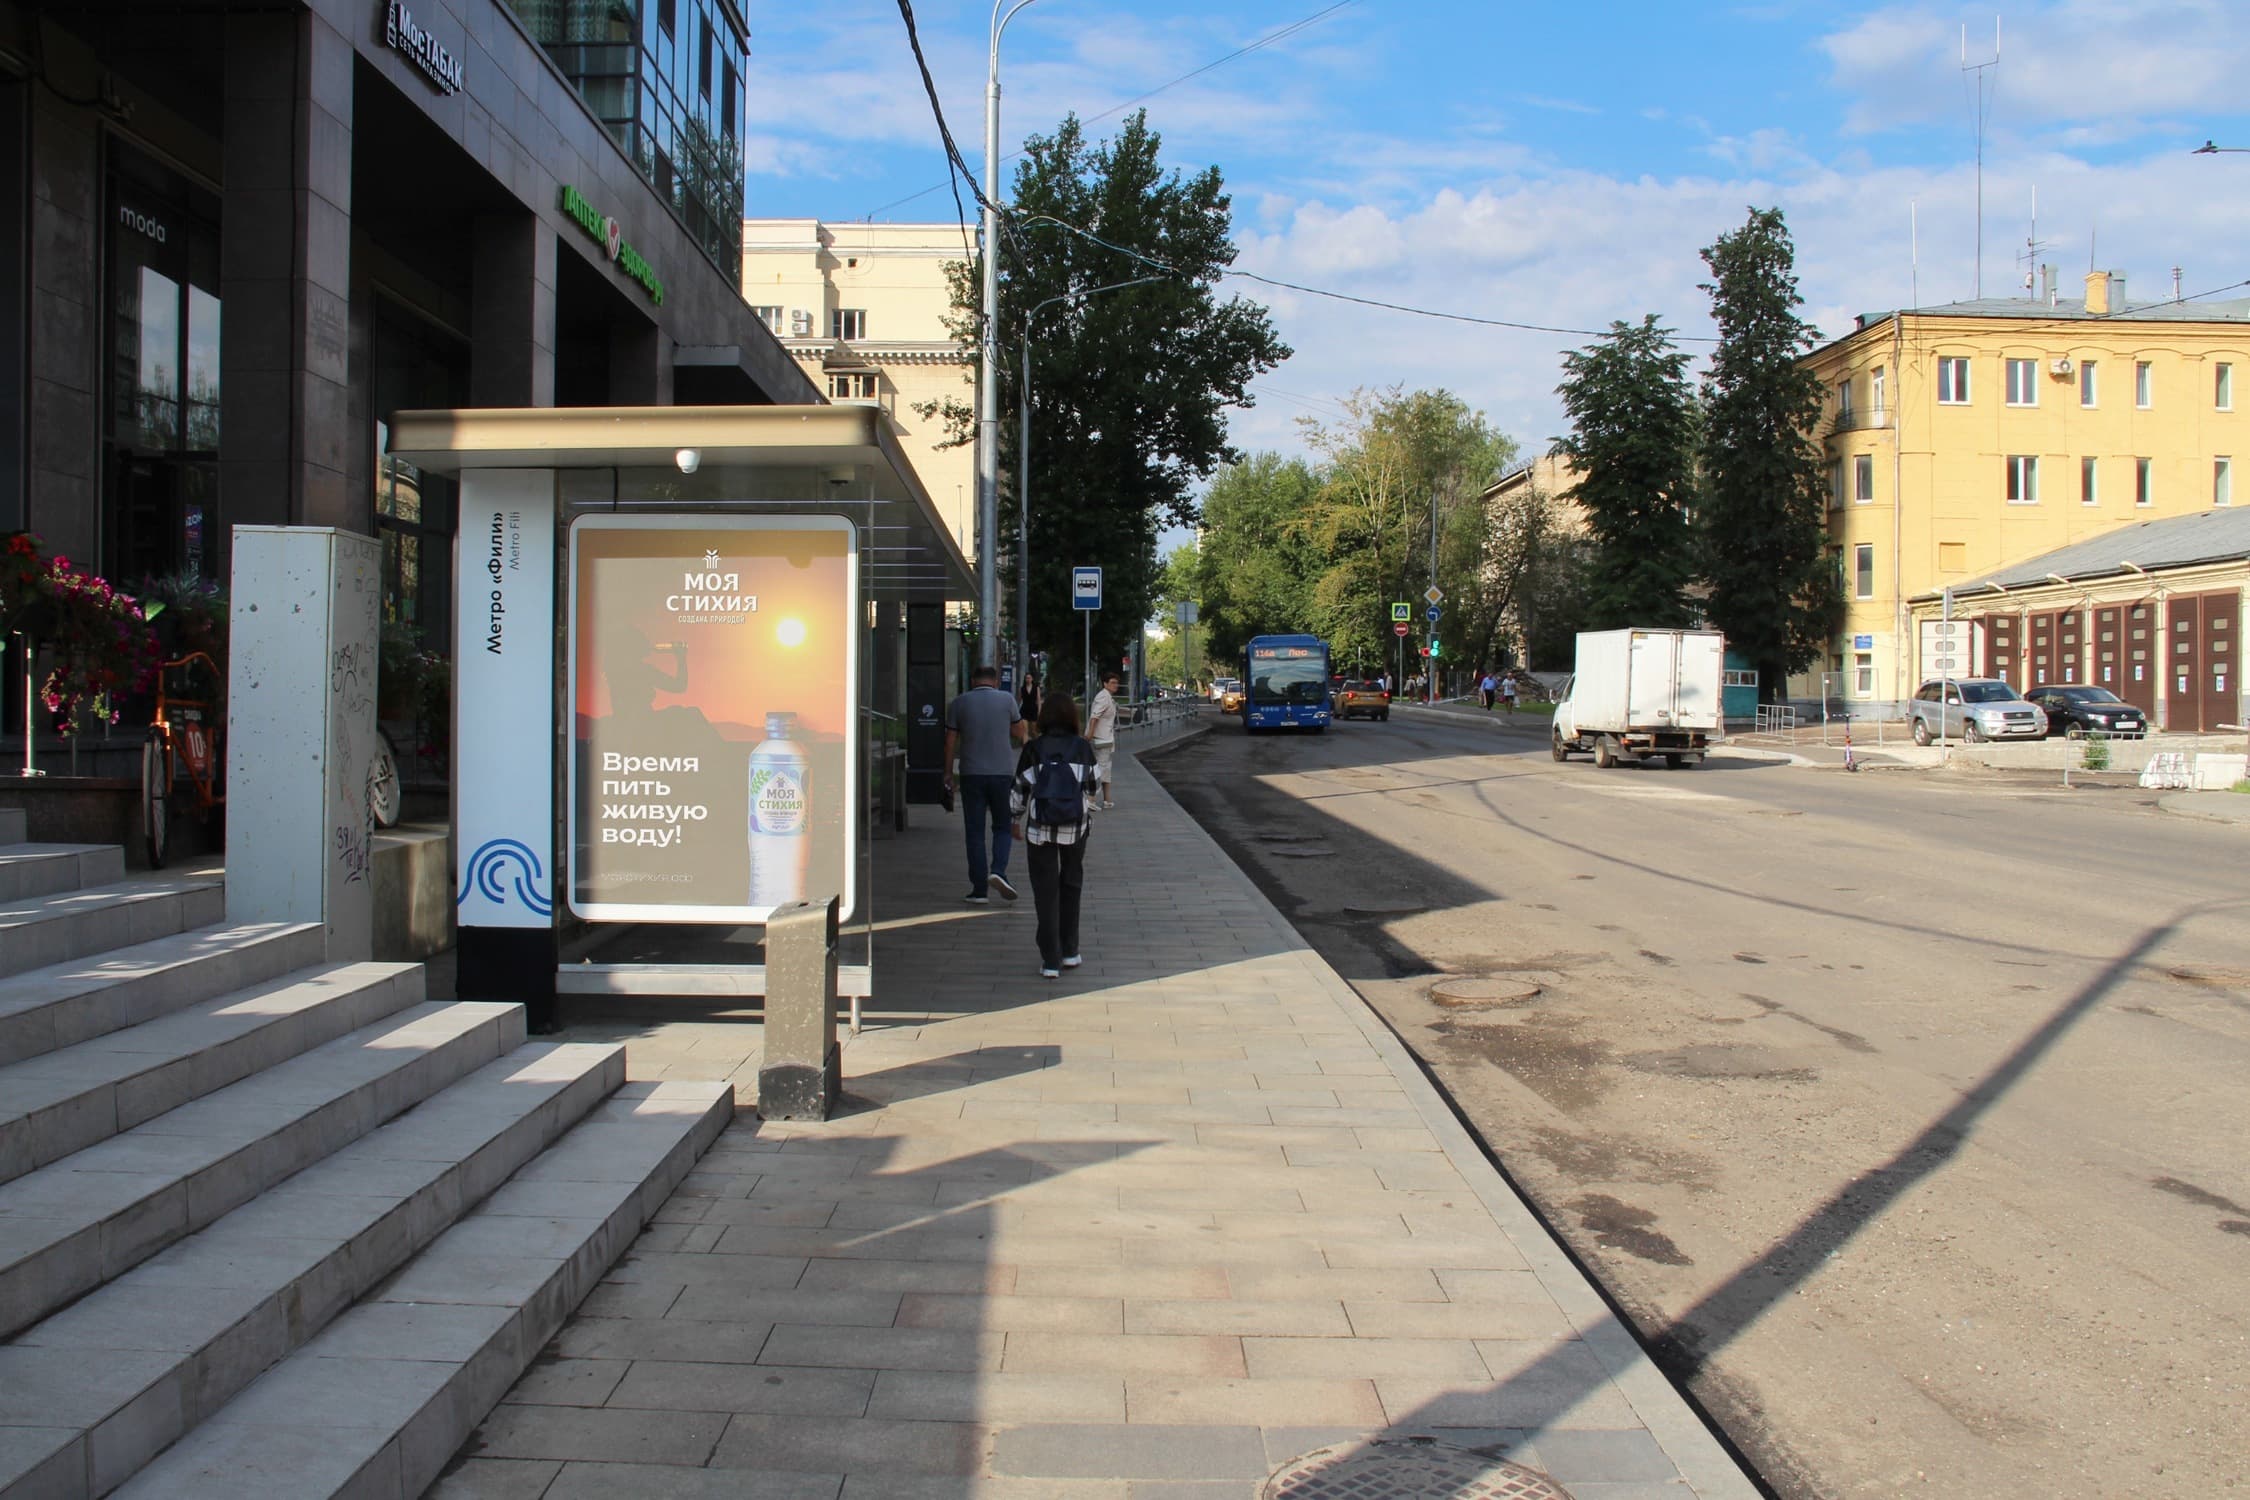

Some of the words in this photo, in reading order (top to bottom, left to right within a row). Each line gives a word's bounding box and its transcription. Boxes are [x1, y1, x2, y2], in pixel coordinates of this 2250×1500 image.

[399, 34, 416, 59] СЕТЬ
[400, 3, 462, 92] МосТАБАК
[120, 205, 166, 242] moda
[509, 511, 520, 529] Fili
[487, 512, 503, 584] «Фили»
[509, 532, 520, 571] Metro
[684, 573, 739, 591] МОЯ
[666, 595, 758, 611] СТИХИЯ
[487, 590, 505, 654] Метро
[678, 615, 708, 623] СОЗДАНА
[710, 614, 745, 624] ПРИРОДОЙ
[603, 752, 699, 775] Время
[602, 780, 671, 796] пить
[766, 788, 795, 799] МОЯ
[602, 804, 708, 823] живую
[759, 800, 803, 810] СТИХИЯ
[602, 825, 682, 848] воду!
